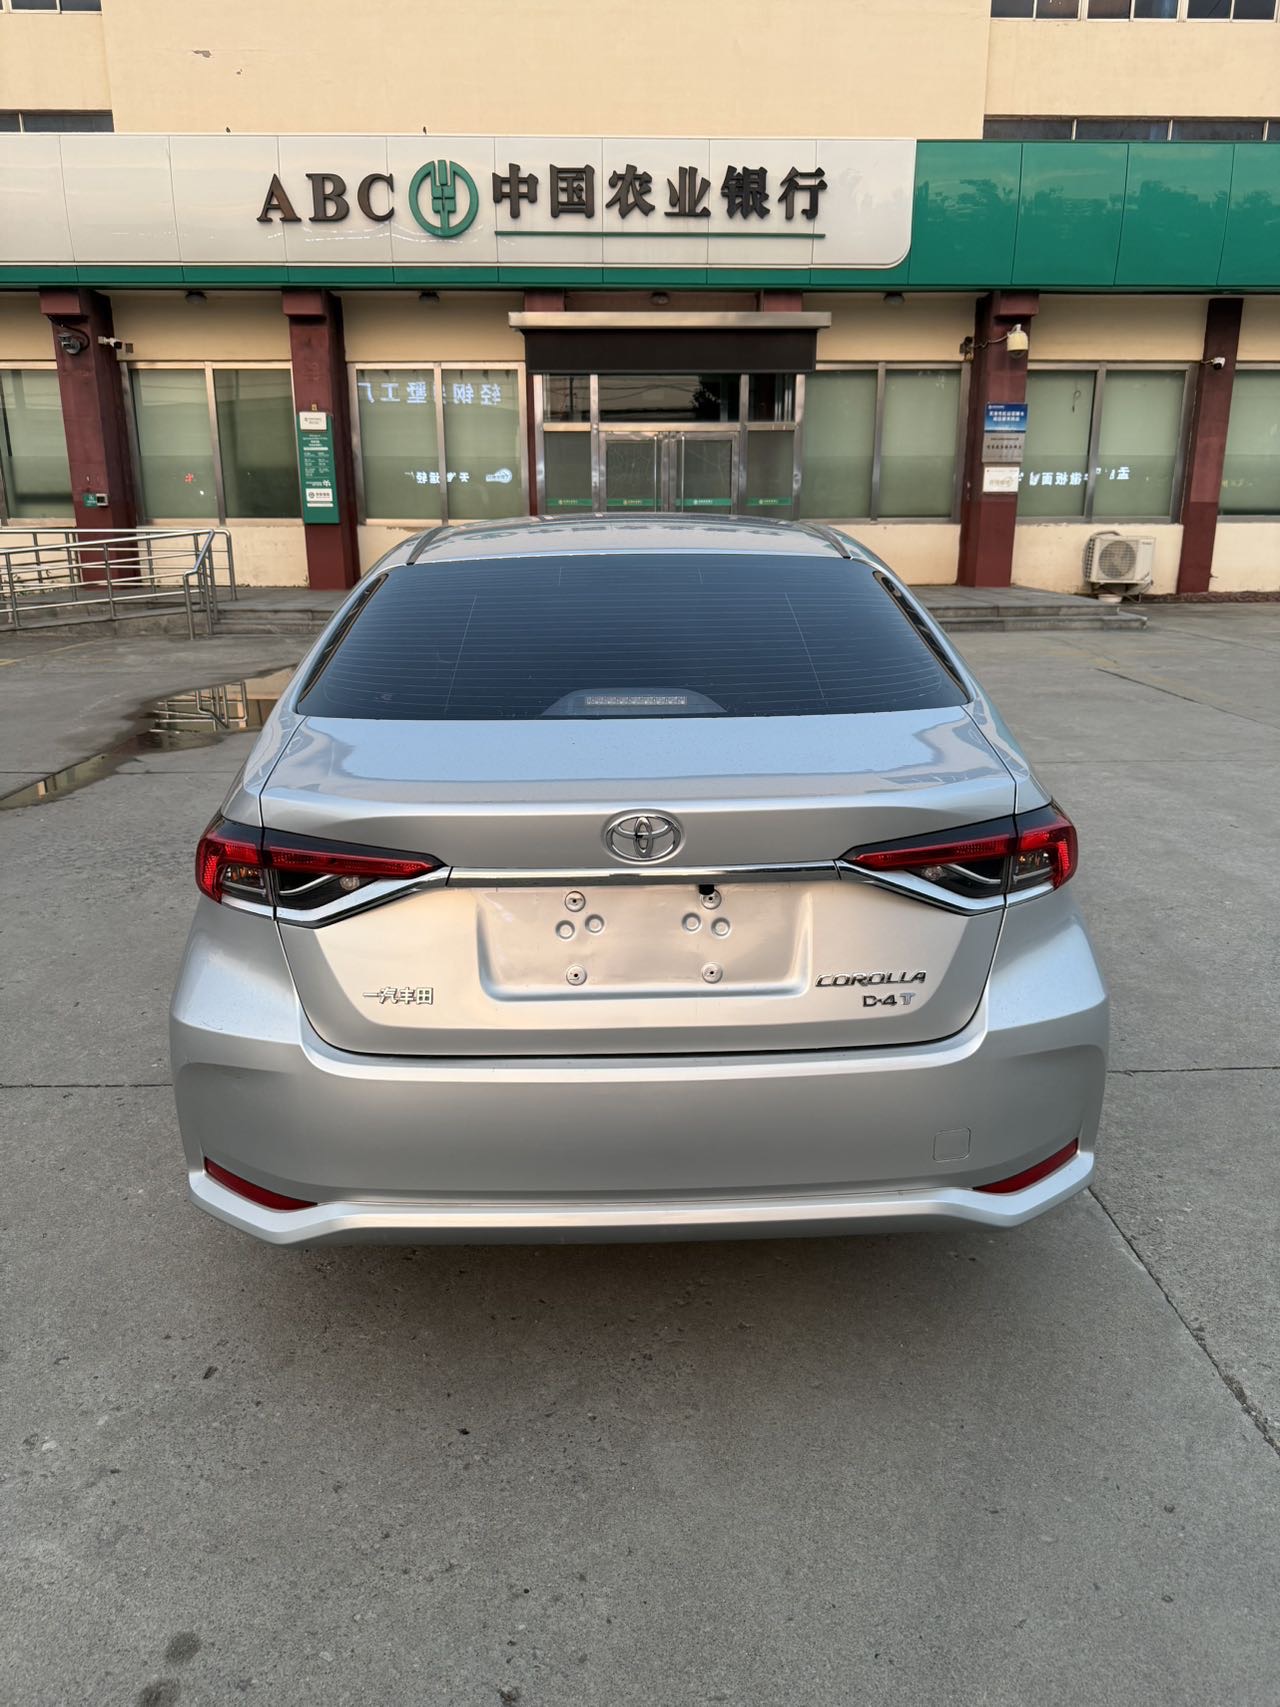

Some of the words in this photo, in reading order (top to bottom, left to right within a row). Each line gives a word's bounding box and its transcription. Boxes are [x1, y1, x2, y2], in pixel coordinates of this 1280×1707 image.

[256, 173, 395, 222] ABC
[492, 162, 827, 220] 中国农业银行
[815, 969, 927, 987] COROLLA
[363, 986, 433, 1005] 一汽丰田
